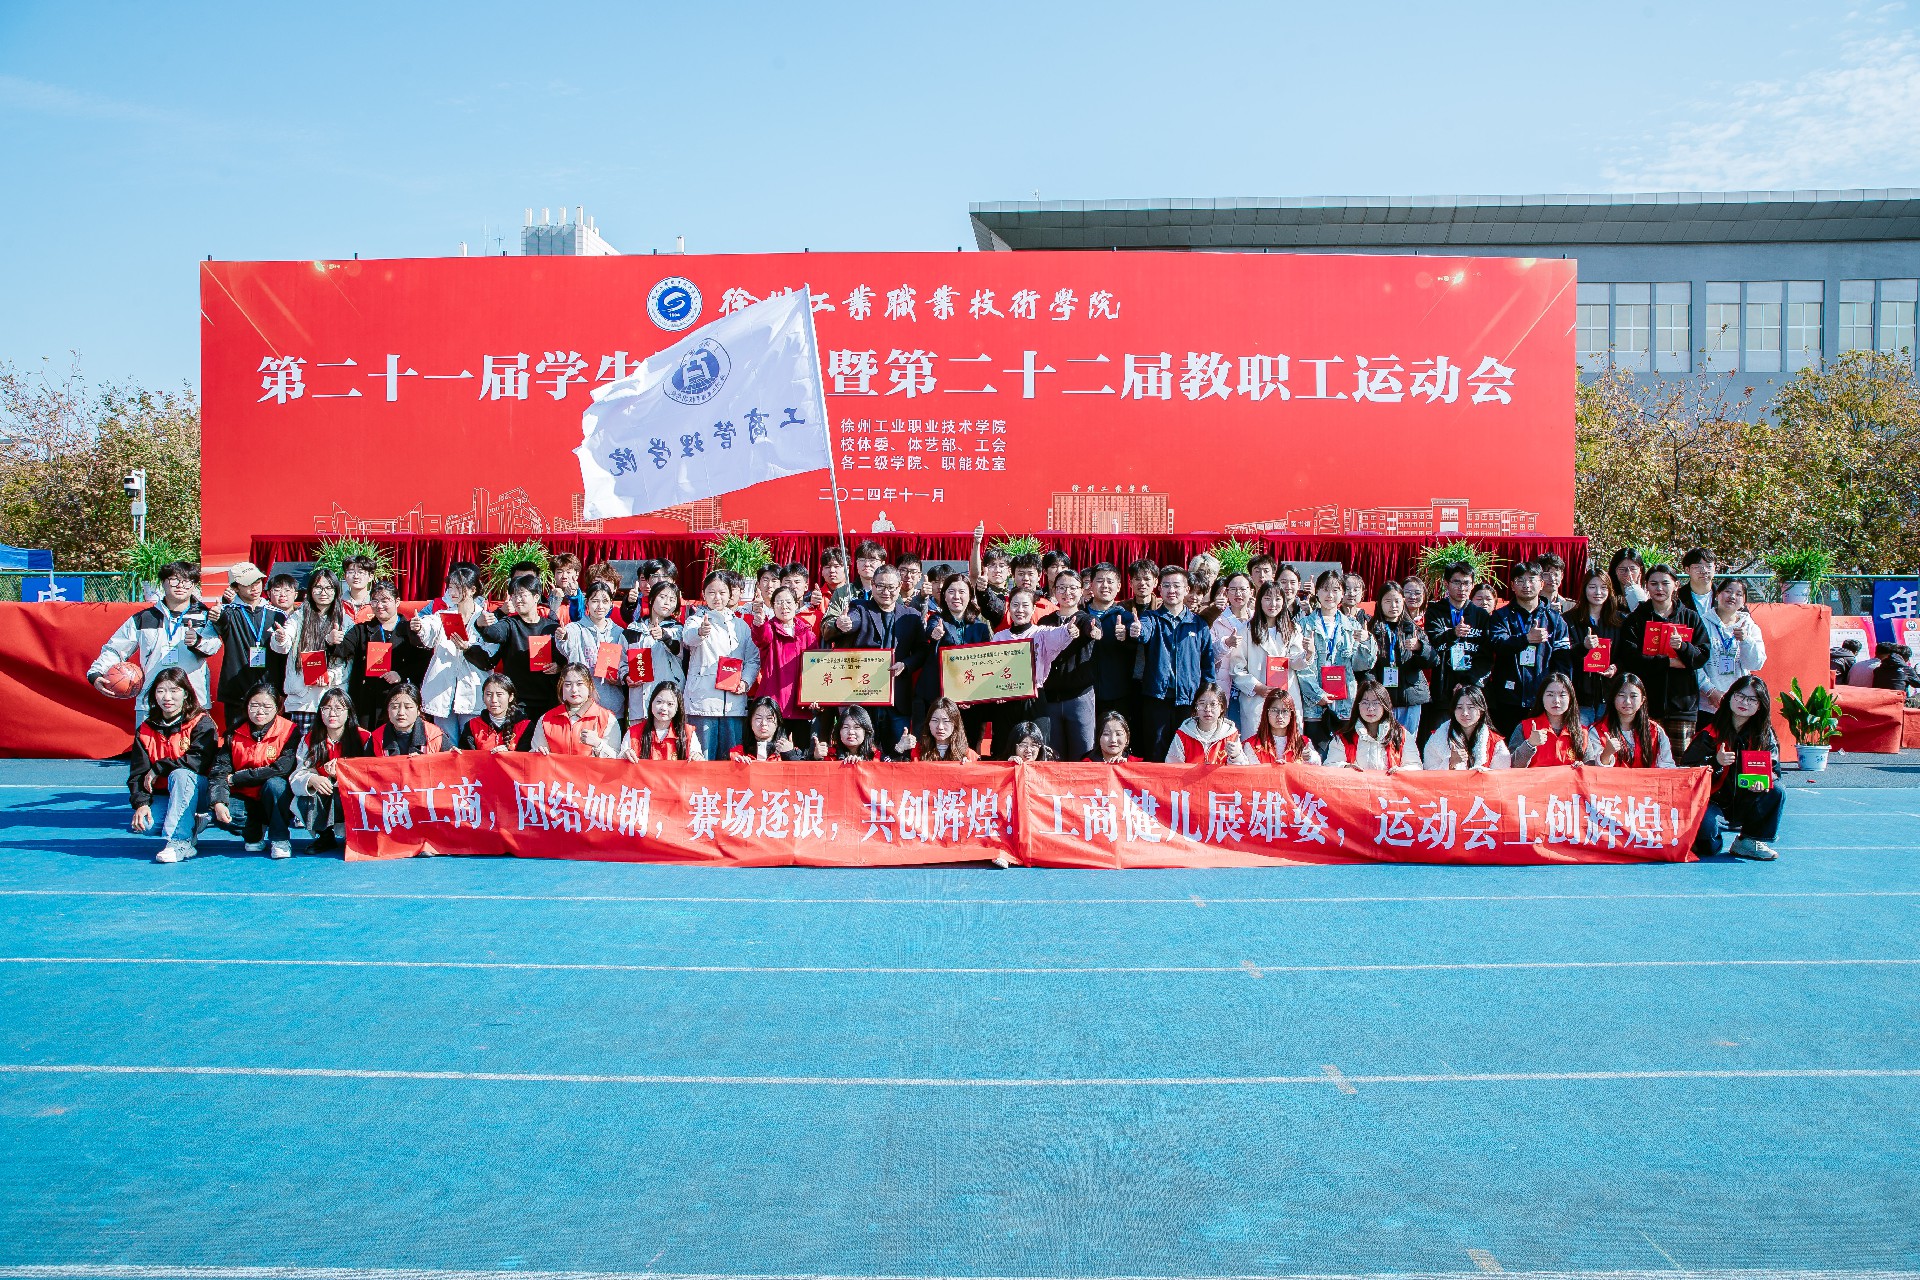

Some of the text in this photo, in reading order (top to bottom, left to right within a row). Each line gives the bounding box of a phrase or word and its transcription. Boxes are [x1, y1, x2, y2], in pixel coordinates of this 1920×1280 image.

[256, 349, 1518, 407] 第二十一届学生暨第二十二届教职工运动会
[840, 418, 1007, 435] 徐州工业职业技术学院
[840, 437, 1007, 453] 校体委、体艺部、工会
[840, 455, 1007, 471] 各二级学院、职能处室
[821, 671, 871, 687] 第一名
[963, 666, 1012, 685] 第一名
[348, 776, 1015, 844] 工商工商，团结如钢，赛场逐浪，共创辉煌！
[1038, 786, 1683, 850] 工商健儿展雄姿，运动会上创辉煌！
